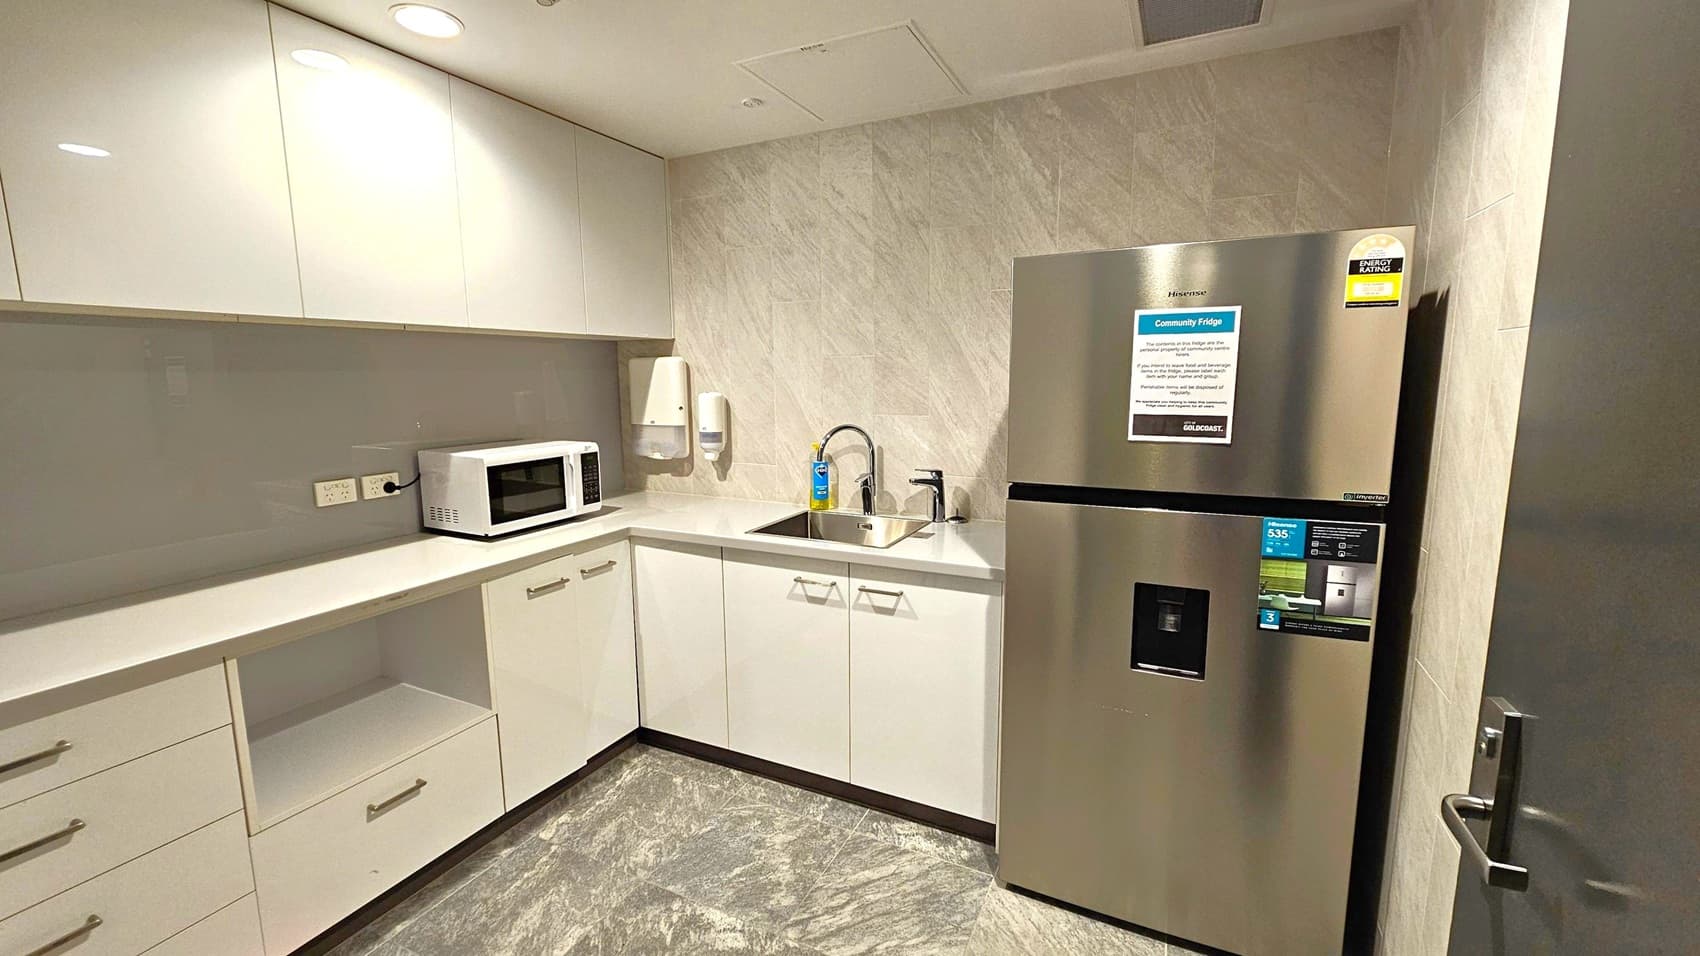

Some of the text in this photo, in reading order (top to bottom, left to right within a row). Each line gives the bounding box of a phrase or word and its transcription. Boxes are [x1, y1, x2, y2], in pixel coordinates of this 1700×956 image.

[1360, 258, 1392, 267] ENERGY
[1168, 290, 1207, 298] Hisense
[1154, 317, 1222, 328] Community Fridge
[1268, 521, 1297, 529] Hisense
[1267, 528, 1289, 539] 535
[1266, 612, 1274, 622] 3
